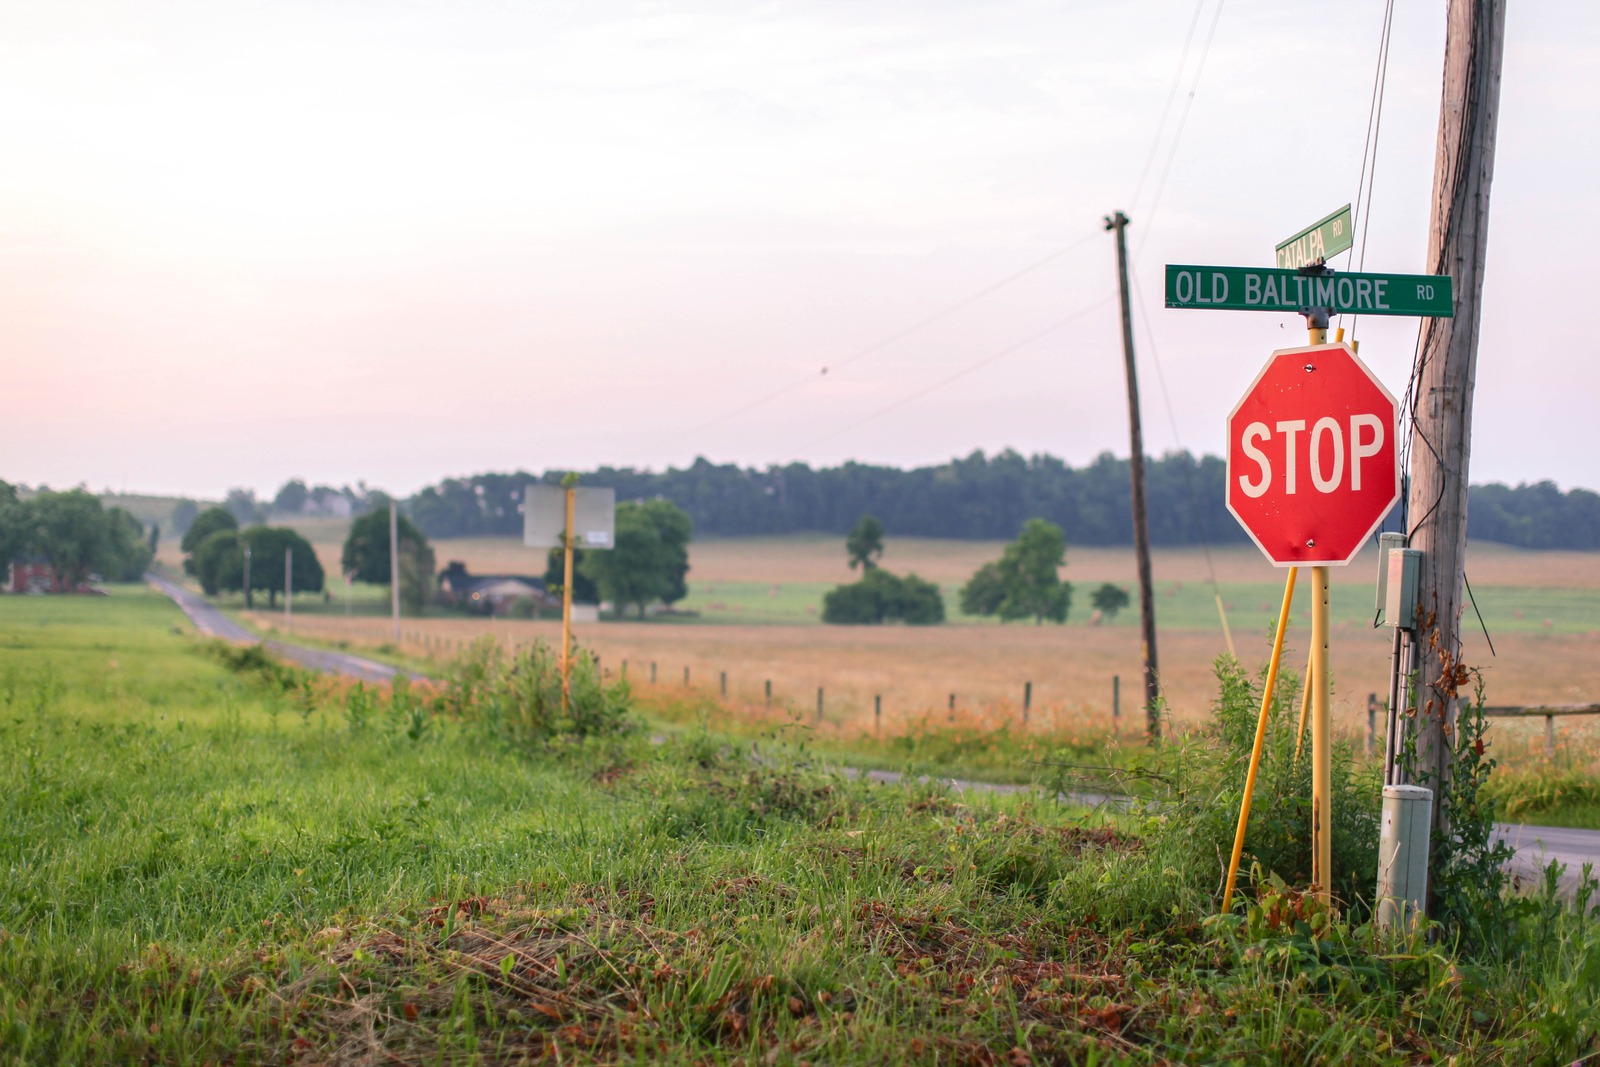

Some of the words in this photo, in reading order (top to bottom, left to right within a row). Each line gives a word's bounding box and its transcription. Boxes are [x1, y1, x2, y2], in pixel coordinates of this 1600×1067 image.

[1277, 226, 1325, 269] CATALPA
[1332, 219, 1343, 238] RD
[1175, 271, 1229, 303] OLD
[1245, 273, 1390, 309] BALTIMORE
[1416, 284, 1435, 300] RD
[1239, 413, 1385, 498] STOP
